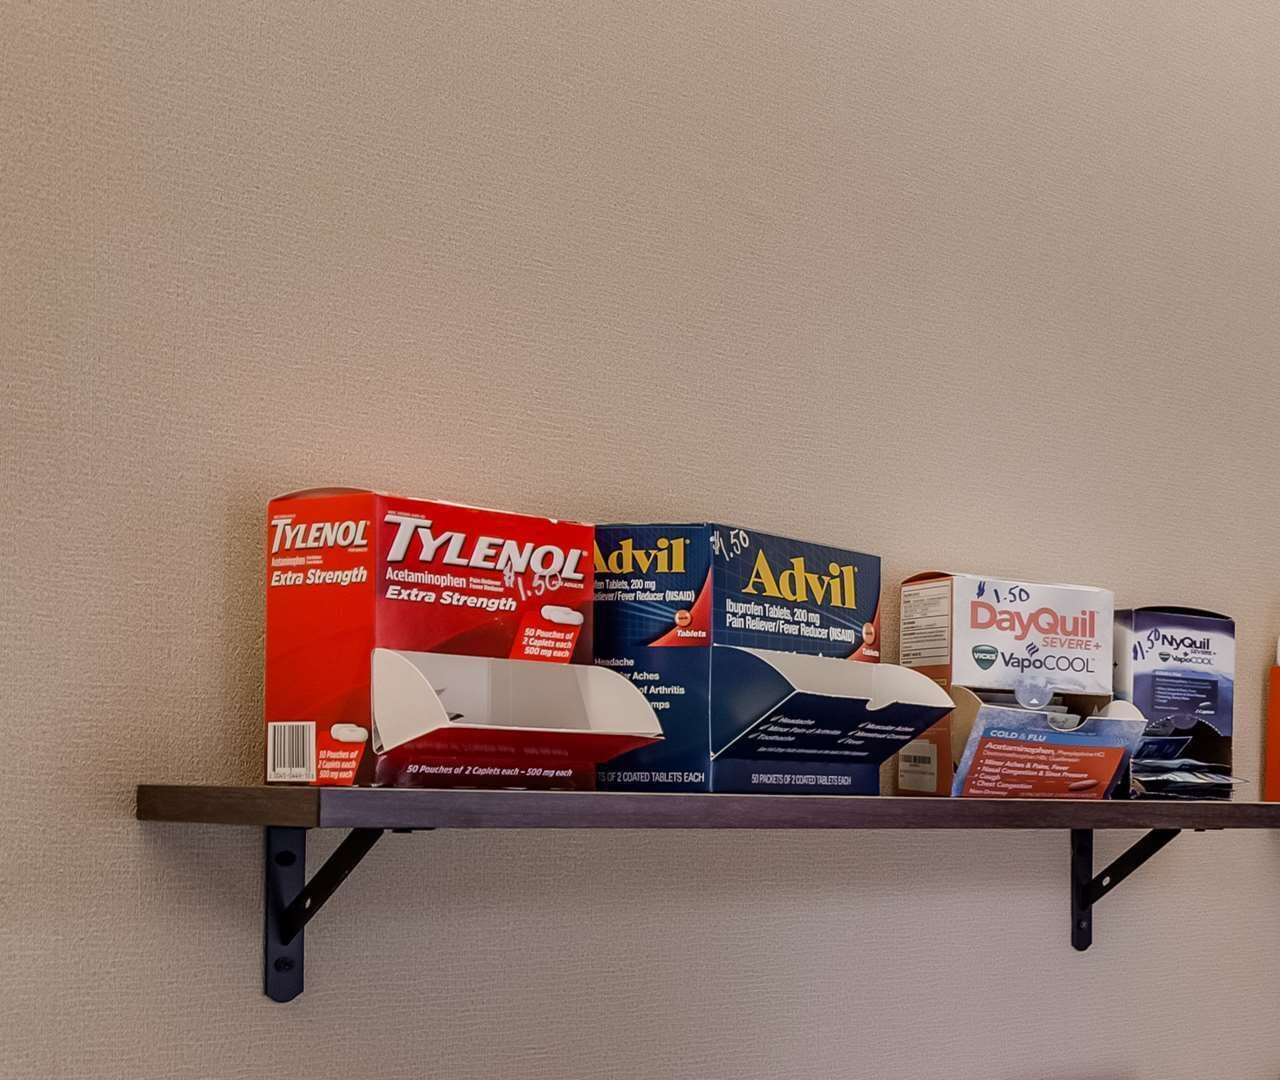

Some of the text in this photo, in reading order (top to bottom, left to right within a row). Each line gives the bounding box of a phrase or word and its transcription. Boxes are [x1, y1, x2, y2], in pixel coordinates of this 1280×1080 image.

[271, 519, 367, 554] TYLENOL
[384, 514, 585, 580] TYLENOL
[271, 566, 367, 586] Extra Strength
[386, 567, 467, 588] Acetaminophen
[742, 549, 858, 609] Advil
[386, 585, 518, 613] Extra Strength
[726, 599, 762, 620] Ibuprofen
[794, 608, 807, 621] 200
[726, 615, 744, 629] Pain
[800, 624, 828, 639] Reducer
[969, 600, 1096, 641] DayQuil
[1162, 634, 1210, 651] NyQuil
[594, 657, 635, 667] Headache
[1001, 651, 1095, 674] VapoCOOL
[632, 671, 660, 681] Aches
[649, 685, 685, 695] Arthritis
[989, 729, 1047, 743] COLD FLU
